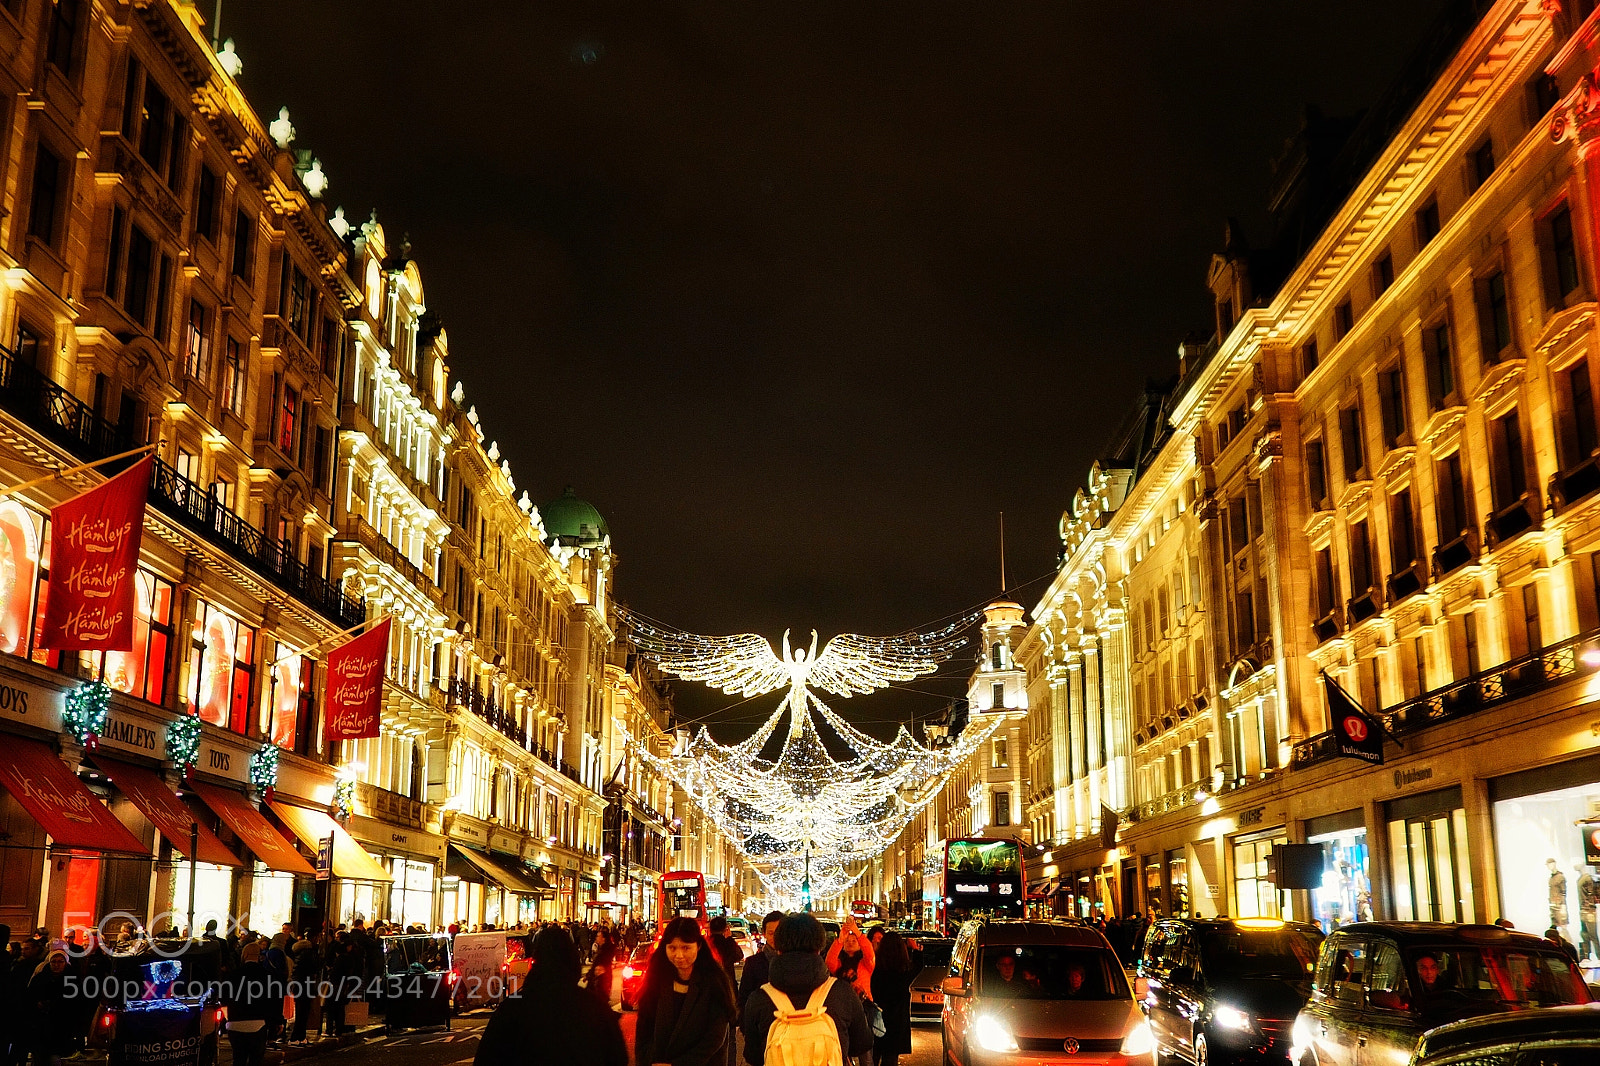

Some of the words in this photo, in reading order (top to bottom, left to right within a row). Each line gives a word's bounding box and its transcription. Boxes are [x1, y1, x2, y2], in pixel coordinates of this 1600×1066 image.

[65, 514, 131, 550] Hamleys
[64, 559, 126, 595] Hamleys
[60, 602, 123, 638] Hamleys
[334, 655, 378, 676] Hamleys
[0, 684, 28, 714] OYS
[333, 682, 376, 704] Hamleys
[331, 709, 373, 733] Hamleys
[103, 718, 156, 750] HAMLEYS
[209, 749, 230, 771] TOYS
[1342, 745, 1379, 760] lulumon
[998, 883, 1013, 895] 23
